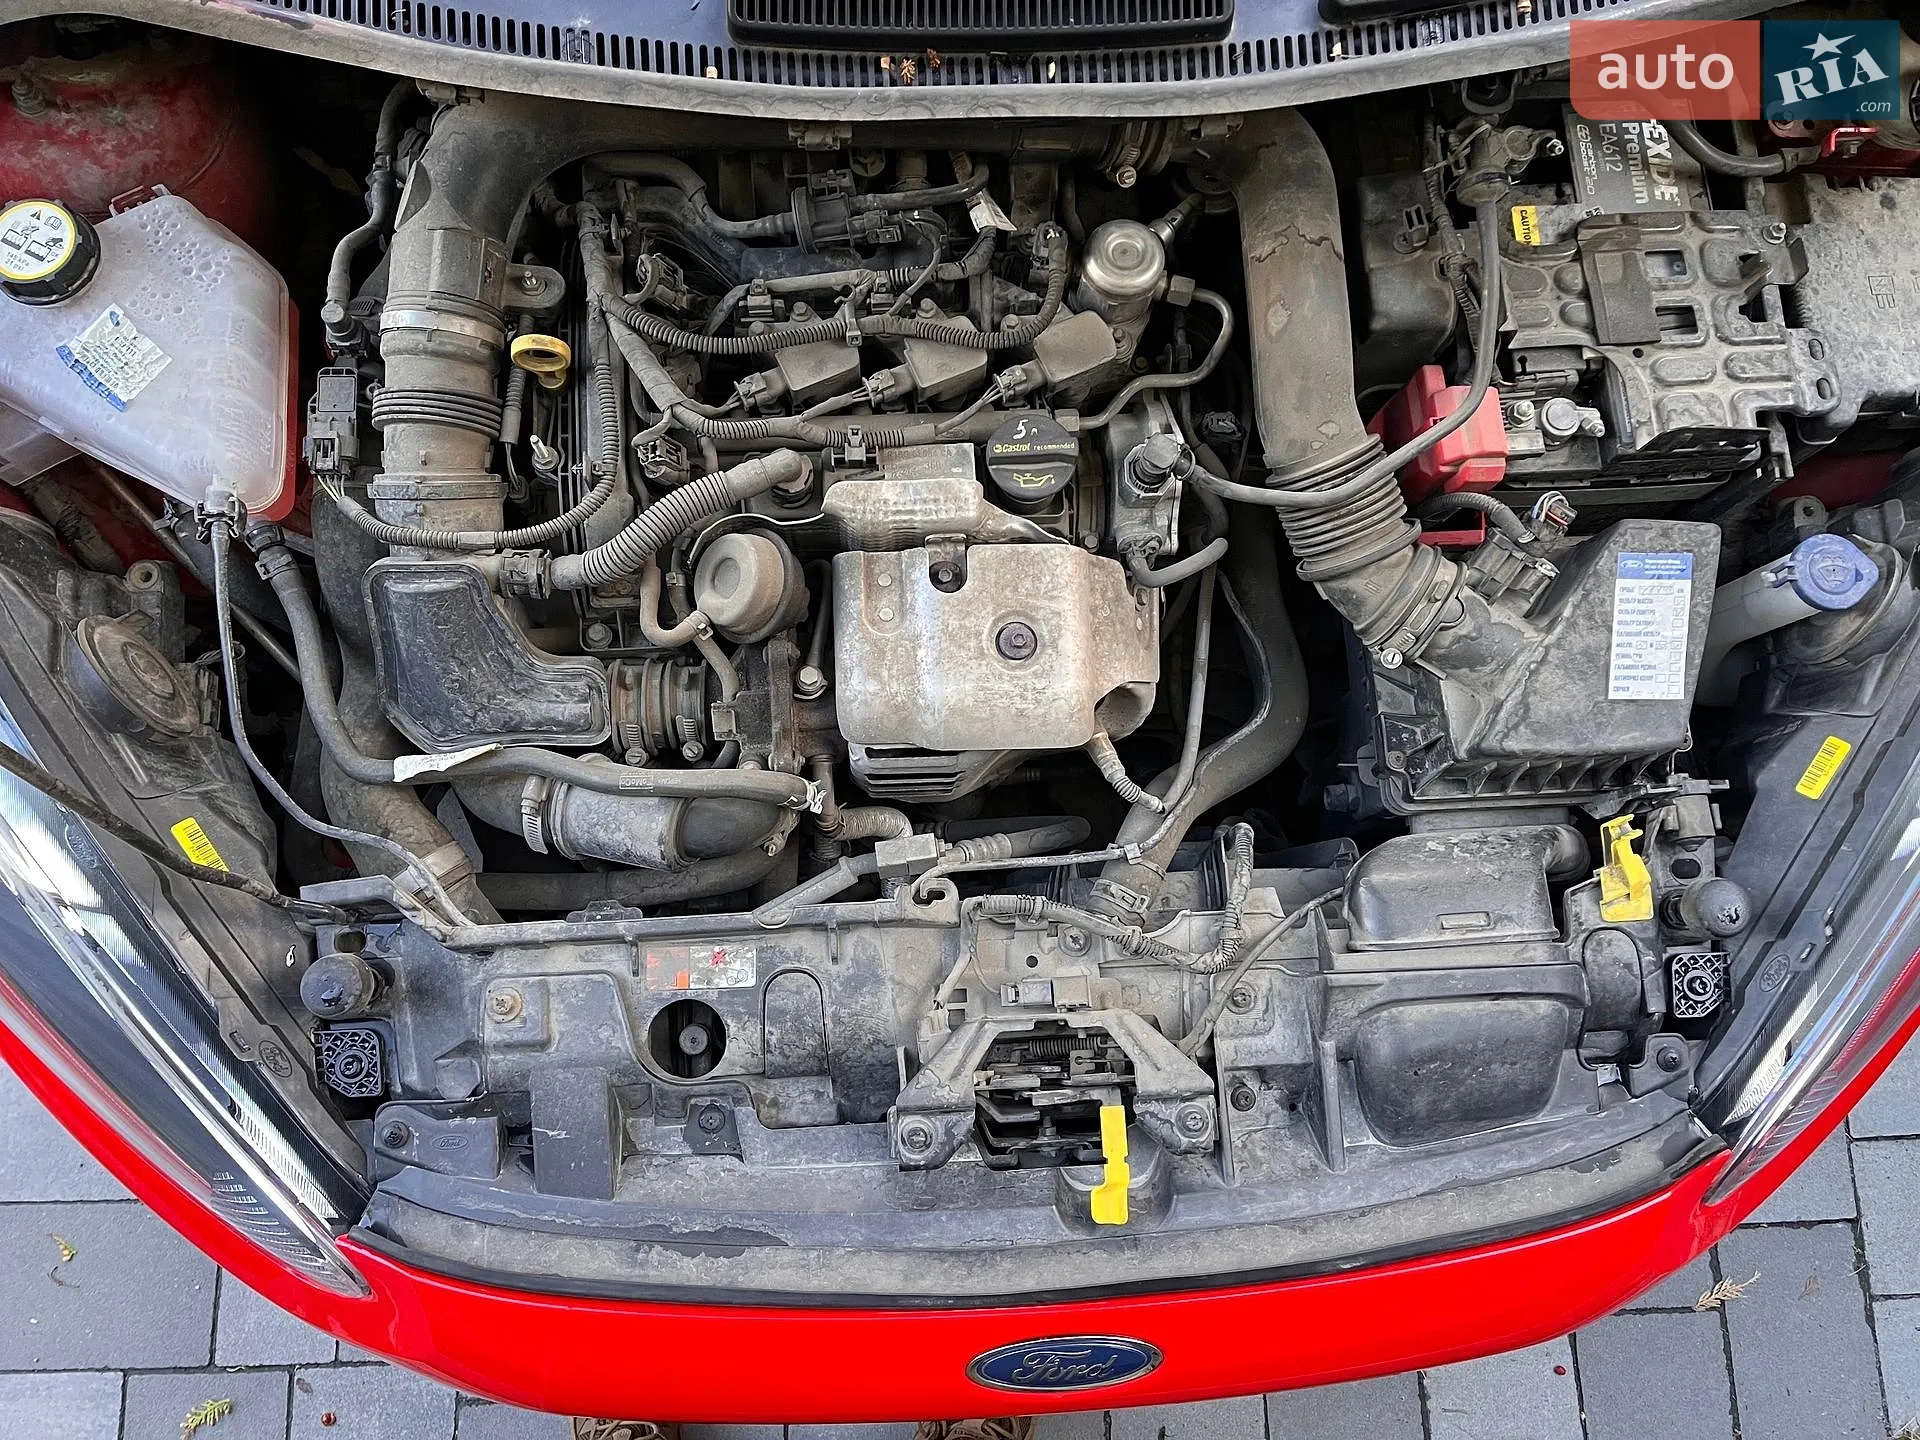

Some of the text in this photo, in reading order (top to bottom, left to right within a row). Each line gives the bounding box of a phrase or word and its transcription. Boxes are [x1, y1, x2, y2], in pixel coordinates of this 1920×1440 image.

[1599, 123, 1622, 172] EA612
[1622, 122, 1650, 204] Premium
[1642, 119, 1679, 201] EXIDE
[1003, 442, 1075, 453] Castrol recommended
[1013, 419, 1029, 440] 5
[1011, 1350, 1118, 1383] Ford
